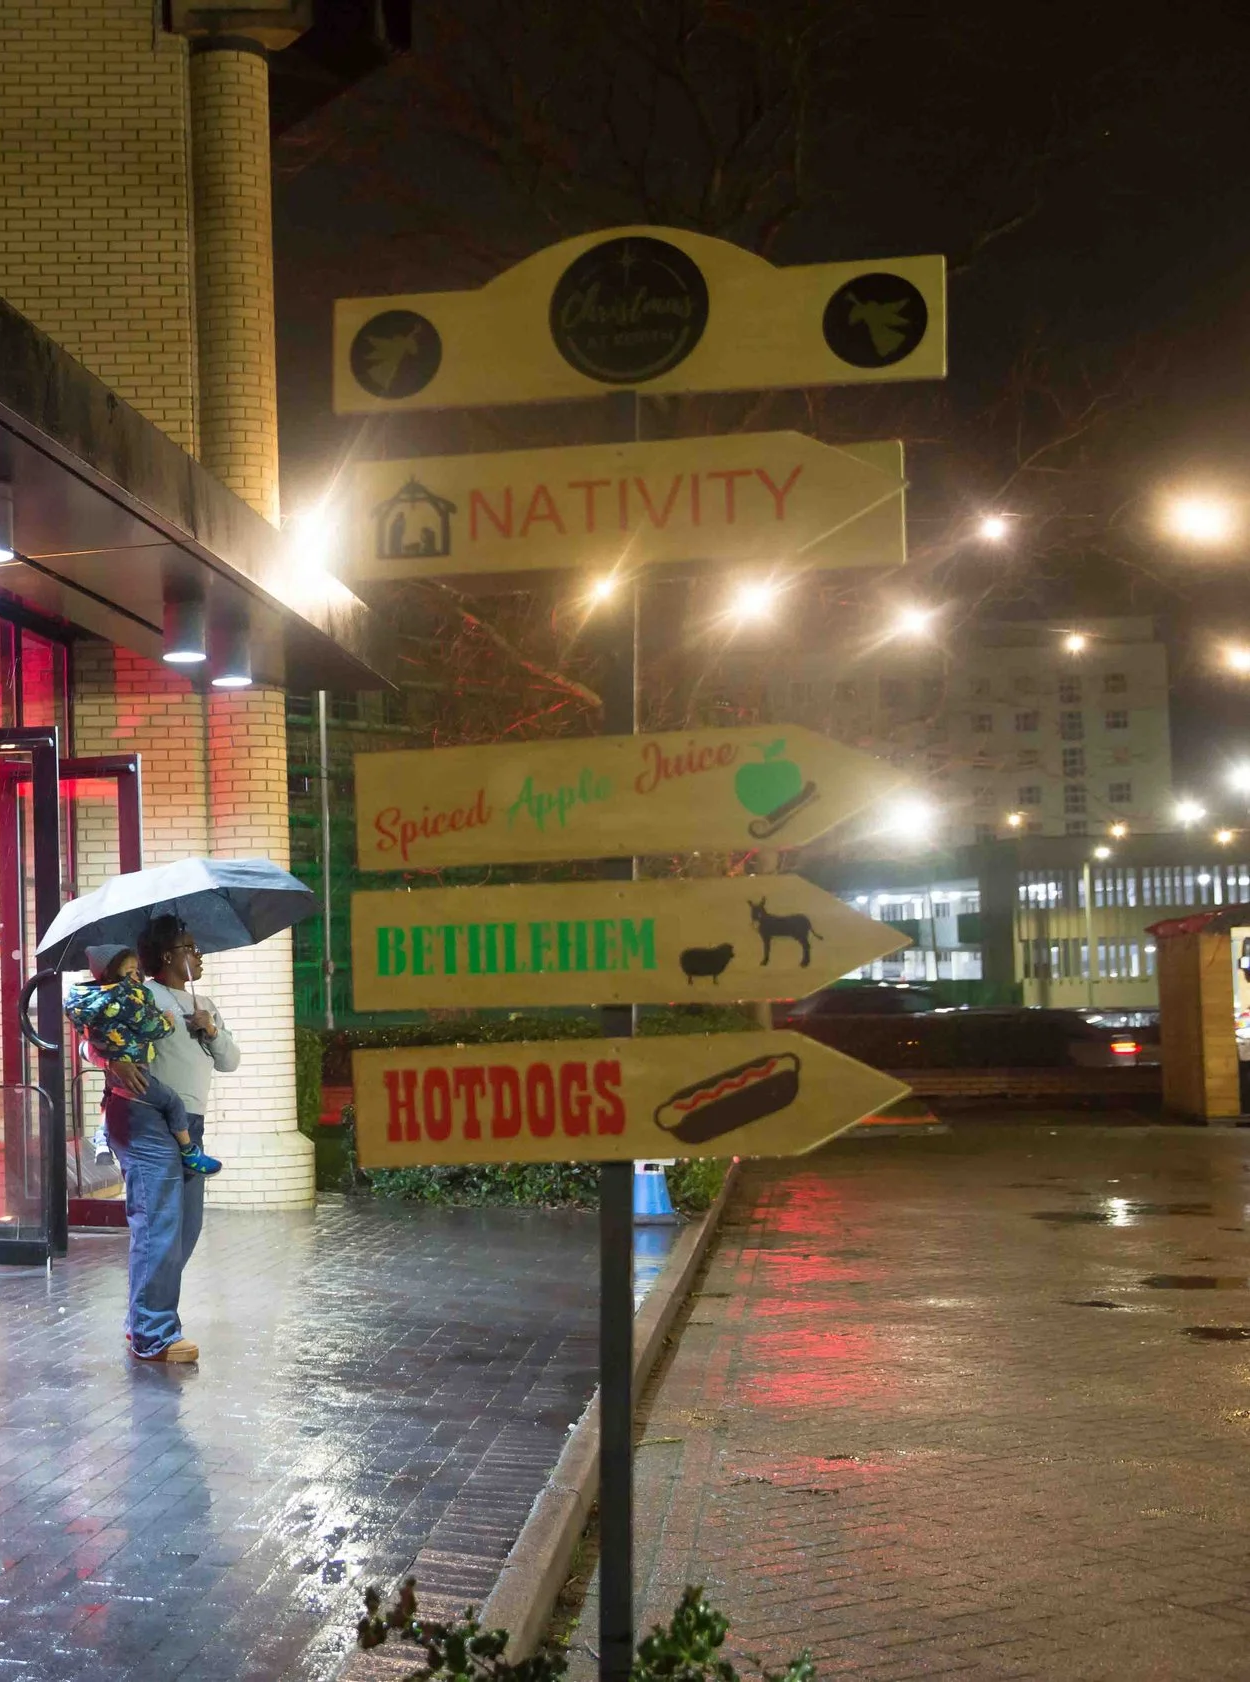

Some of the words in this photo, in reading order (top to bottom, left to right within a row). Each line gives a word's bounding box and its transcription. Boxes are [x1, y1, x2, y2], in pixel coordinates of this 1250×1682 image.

[468, 464, 804, 541] NATIVITY
[374, 788, 493, 862] Spiced
[507, 767, 613, 833] Apple
[634, 740, 738, 796] Juice
[375, 918, 658, 977] BETHLEHEM
[383, 1059, 627, 1143] HOTDOGS
